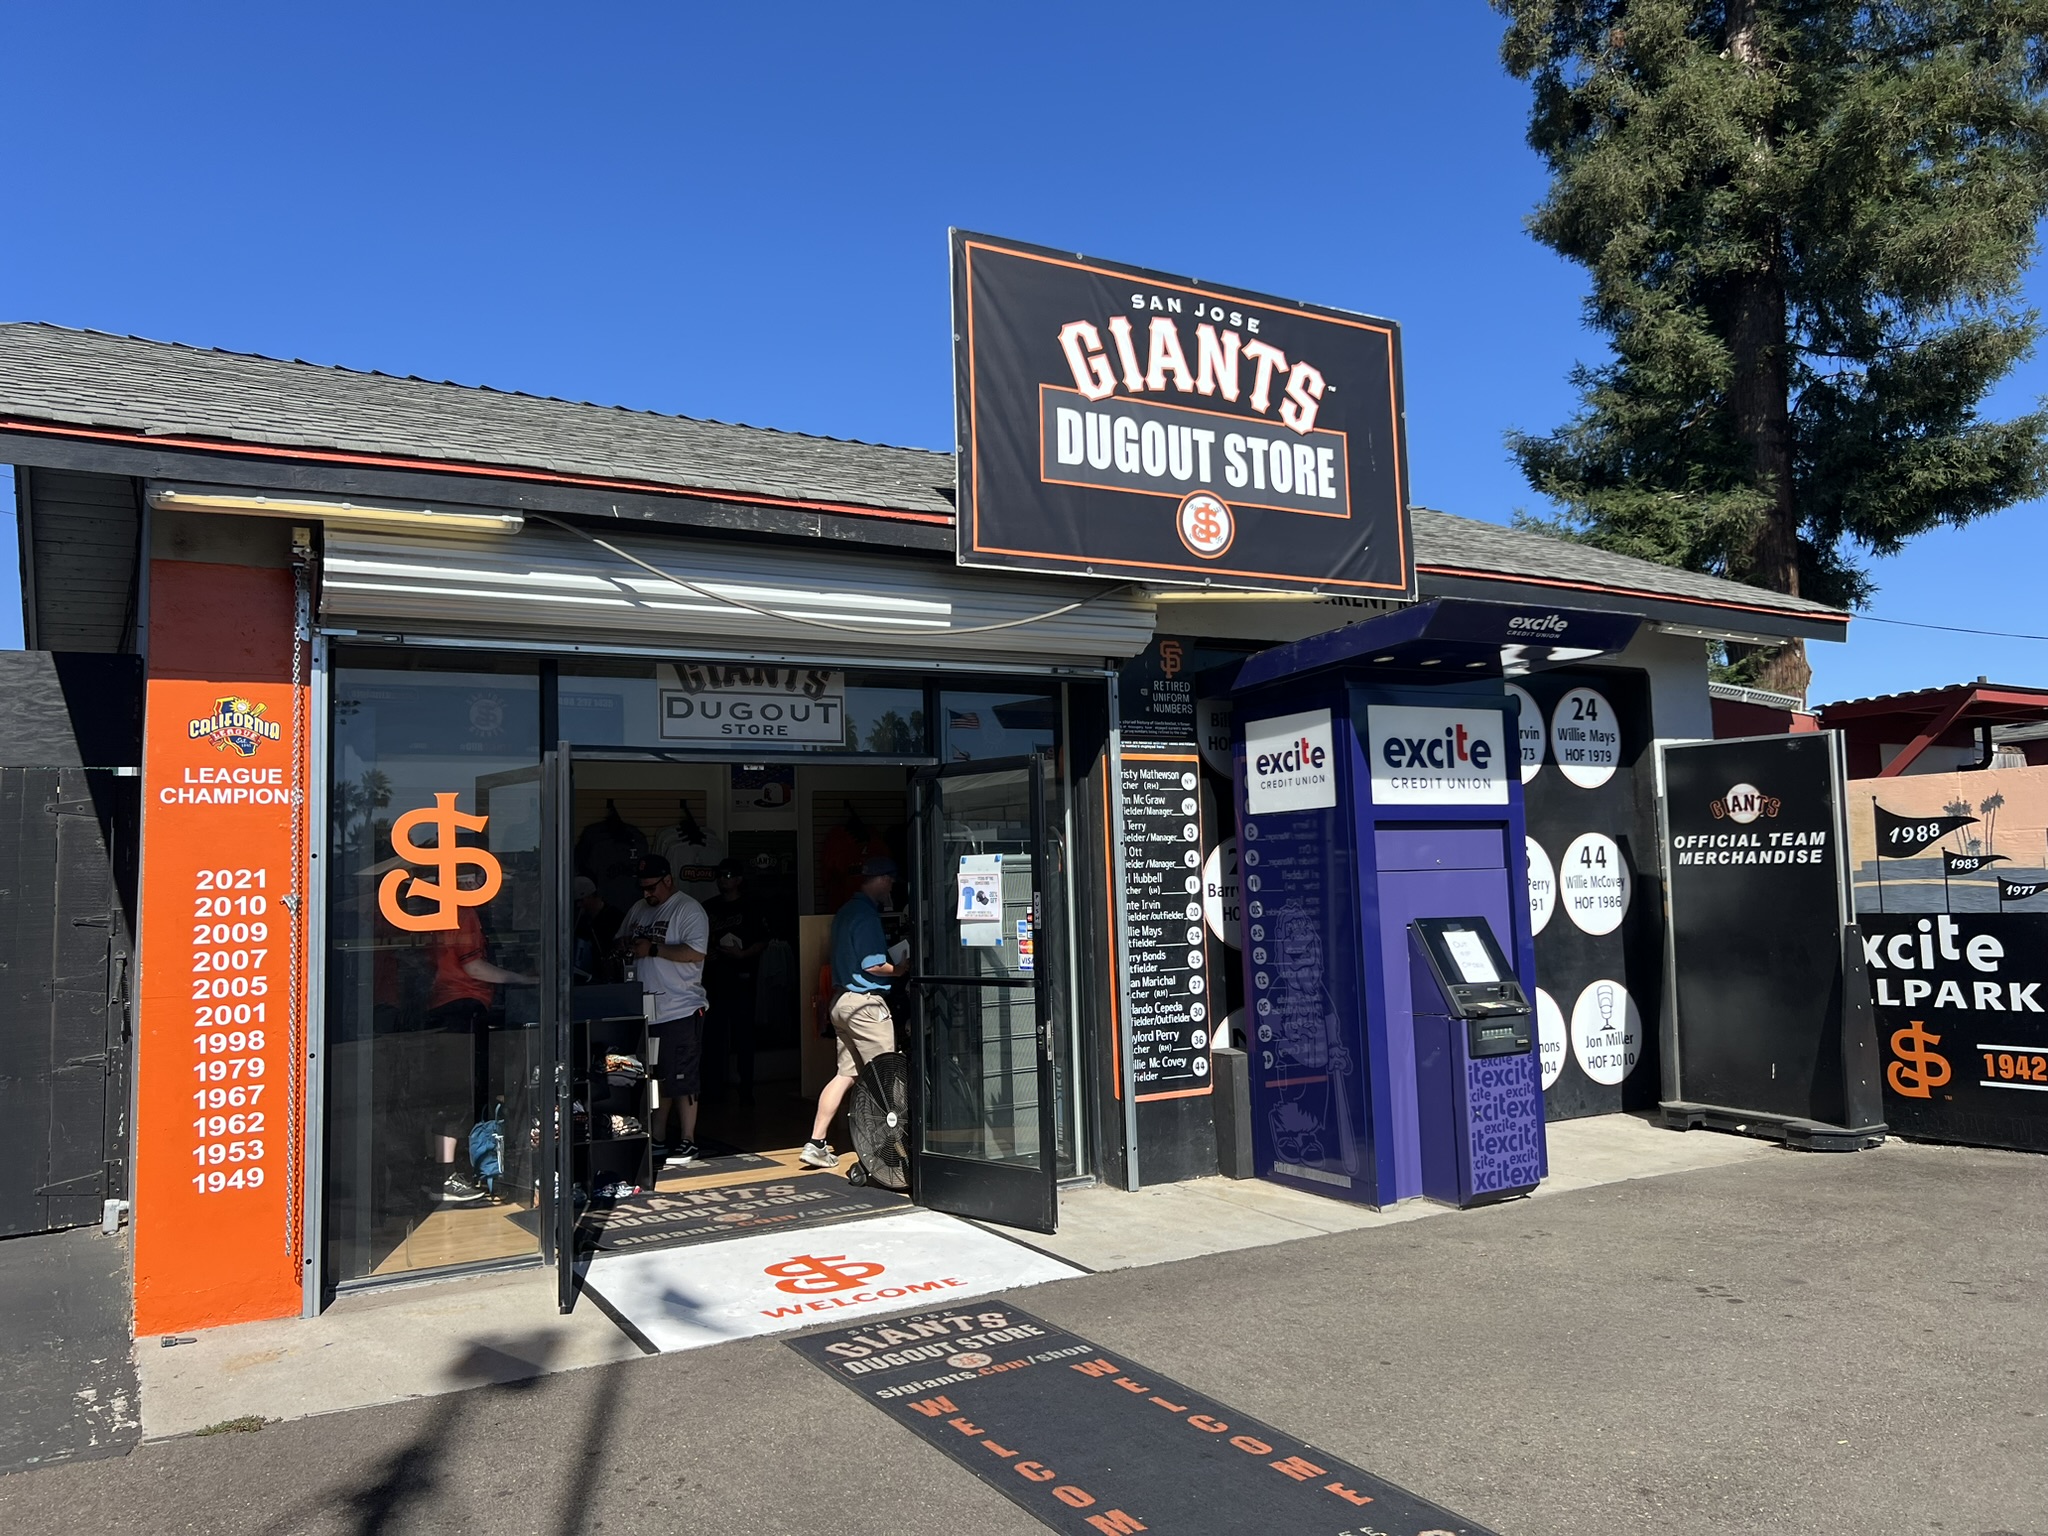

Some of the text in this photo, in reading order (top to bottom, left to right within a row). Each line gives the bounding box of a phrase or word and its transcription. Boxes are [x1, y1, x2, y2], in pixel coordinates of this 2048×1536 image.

[1131, 293, 1262, 335] SAN JOSE
[1057, 315, 1327, 436] GIANTS
[1056, 406, 1337, 499] DUGOUT STORE
[1508, 613, 1569, 632] excite
[1153, 680, 1190, 692] RETIRED
[1152, 692, 1190, 703] UNIFORM
[666, 696, 838, 724] DUGOUT
[1153, 703, 1193, 714] NUMBERS
[1571, 697, 1598, 721] 24
[188, 711, 281, 741] CALIFORNIA
[211, 726, 259, 740] LEAGUE
[721, 723, 788, 736] STORE
[1519, 726, 1540, 740] rvin
[1208, 736, 1231, 751] HO
[1557, 727, 1616, 746] Willie Mays
[1383, 723, 1492, 770] excite
[1565, 748, 1612, 762] HOF 1979
[1256, 737, 1326, 776] excite
[184, 767, 283, 785] LEAGUE
[1120, 769, 1138, 781] risty
[1140, 769, 1180, 780] Mathewson
[1260, 774, 1326, 791] CREDIT UNION
[1391, 777, 1492, 790] CREDIT UNION
[1122, 781, 1138, 790] cher
[1121, 794, 1131, 805] hn
[1709, 794, 1782, 820] GIANTS
[1126, 820, 1147, 832] Terry
[1187, 827, 1194, 839] 3
[1888, 822, 1940, 844] 1988
[1673, 831, 1826, 849] OFFICIAL TEAM
[1128, 846, 1143, 857] Ott
[1188, 854, 1195, 865] 4
[1580, 846, 1607, 869] 44
[1678, 849, 1823, 866] MERCHANDISE
[1949, 858, 1979, 870] 1983
[195, 869, 267, 891] 2021
[1133, 872, 1163, 884] Hubbell
[1565, 875, 1625, 892] Willie McCovey
[1126, 886, 1142, 895] cher
[2005, 884, 2037, 896] 1977
[194, 895, 267, 918] 2010
[1126, 899, 1199, 917] nte Irvin 20
[1531, 898, 1544, 911] 91
[1574, 895, 1623, 909] HOF 1986
[192, 922, 268, 945] 2009
[1127, 925, 1200, 941] llie Mays 24
[1128, 939, 1157, 948] tfielder
[1861, 914, 2005, 973] xcite
[192, 949, 268, 973] 2007
[1129, 950, 1201, 964] rry Bonds 25
[1130, 962, 1158, 974] tfielder
[192, 975, 268, 1000] 2005
[1130, 975, 1201, 989] an Marichal 27
[1131, 989, 1150, 999] cher
[1876, 978, 2046, 1013] LPARK
[194, 1002, 266, 1028] 2001
[1131, 1001, 1203, 1017] lando Cepeda 30
[193, 1029, 266, 1055] 1998
[1132, 1029, 1204, 1045] ylord Perry 36
[1586, 1031, 1634, 1048] Jon Miller
[1134, 1044, 1151, 1054] cher
[193, 1056, 265, 1082] 1979
[1195, 1061, 1205, 1071] 44
[1588, 1052, 1635, 1069] HOF 2010
[1982, 1053, 2048, 1082] 1942
[1133, 1071, 1159, 1083] fielder
[193, 1084, 265, 1110] 1967
[192, 1111, 265, 1138] 1962
[1484, 1117, 1516, 1135] excite
[192, 1139, 265, 1166] 1953
[191, 1166, 265, 1194] 1949
[730, 1191, 832, 1211] STORE
[760, 1277, 969, 1319] WELCOME
[847, 1310, 958, 1337] SAN JOSE
[825, 1312, 1009, 1358] GIANTS
[843, 1341, 959, 1376] DUGOUT
[955, 1323, 1046, 1350] STORE
[875, 1343, 1094, 1400] sjgiants.com/shop
